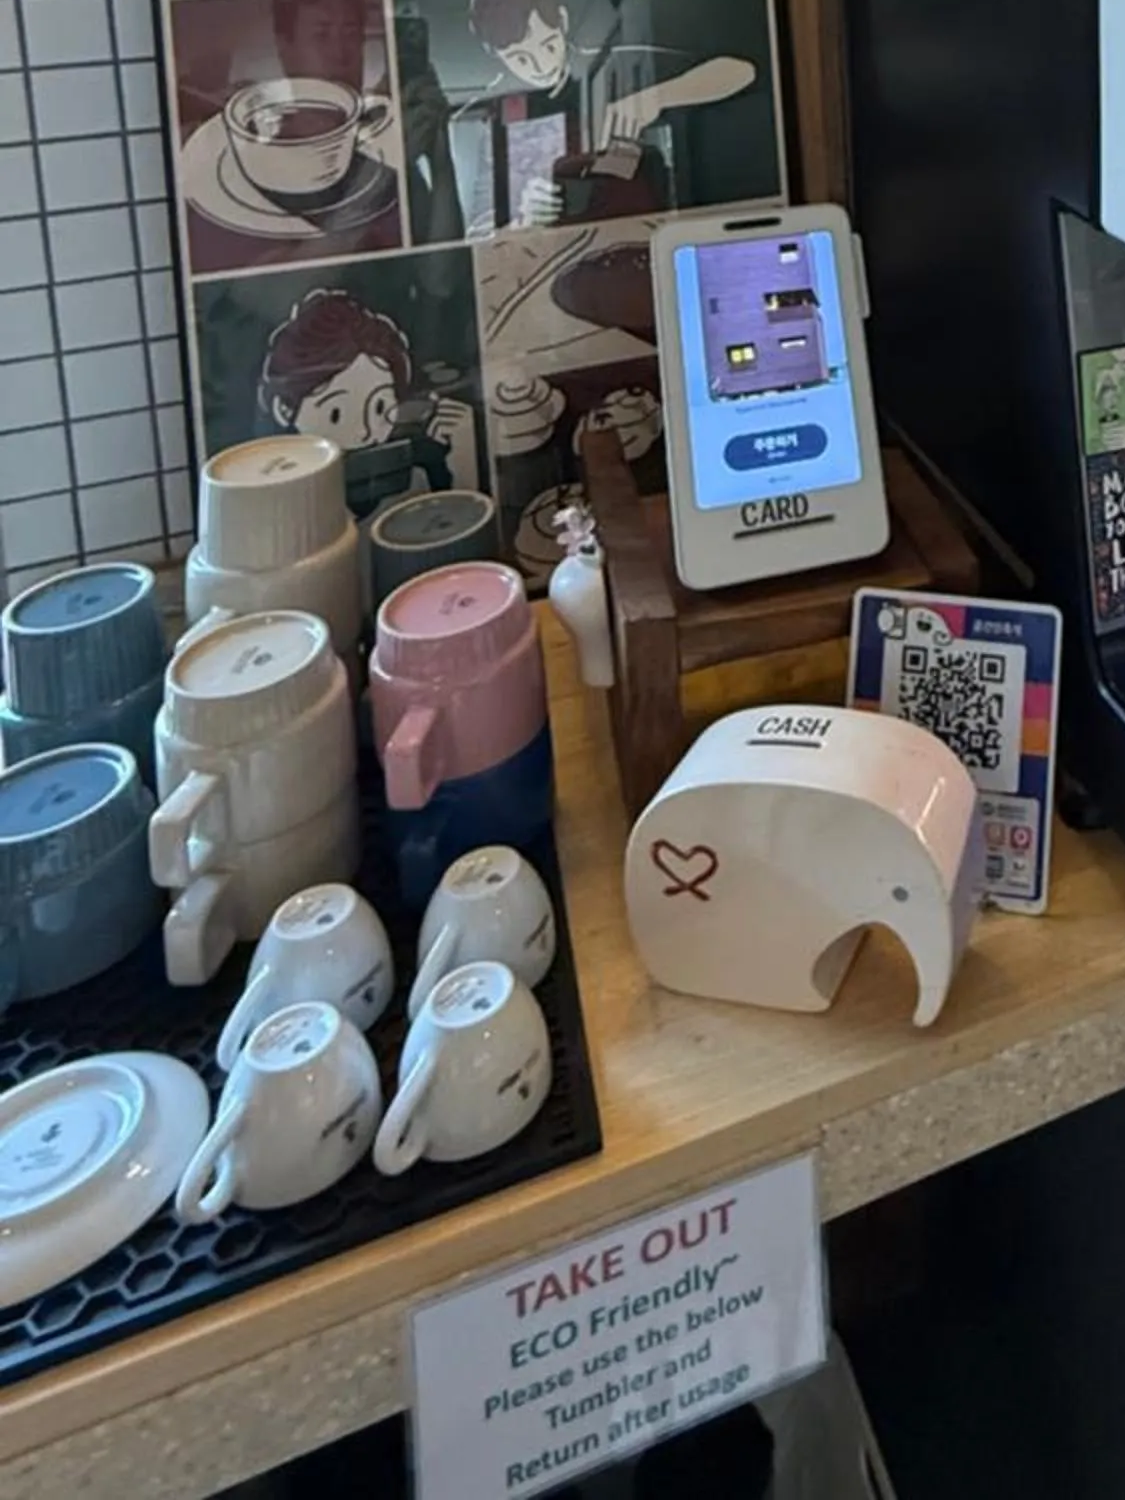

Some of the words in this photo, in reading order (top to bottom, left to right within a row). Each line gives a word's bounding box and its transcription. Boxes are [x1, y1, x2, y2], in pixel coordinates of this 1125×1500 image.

[740, 491, 810, 528] CARD
[756, 716, 833, 737] CASH
[505, 1244, 626, 1319] TAKE
[638, 1197, 738, 1266] OUT
[508, 1320, 579, 1370] ECO
[588, 1252, 740, 1337] Friendly~
[482, 1366, 575, 1421] Please
[581, 1342, 628, 1378] use
[634, 1322, 679, 1354] the
[685, 1284, 765, 1333] below
[543, 1365, 659, 1431] Tumbler
[662, 1337, 713, 1379] and
[505, 1432, 600, 1489] Return
[606, 1397, 671, 1443] after
[676, 1362, 751, 1410] usage
